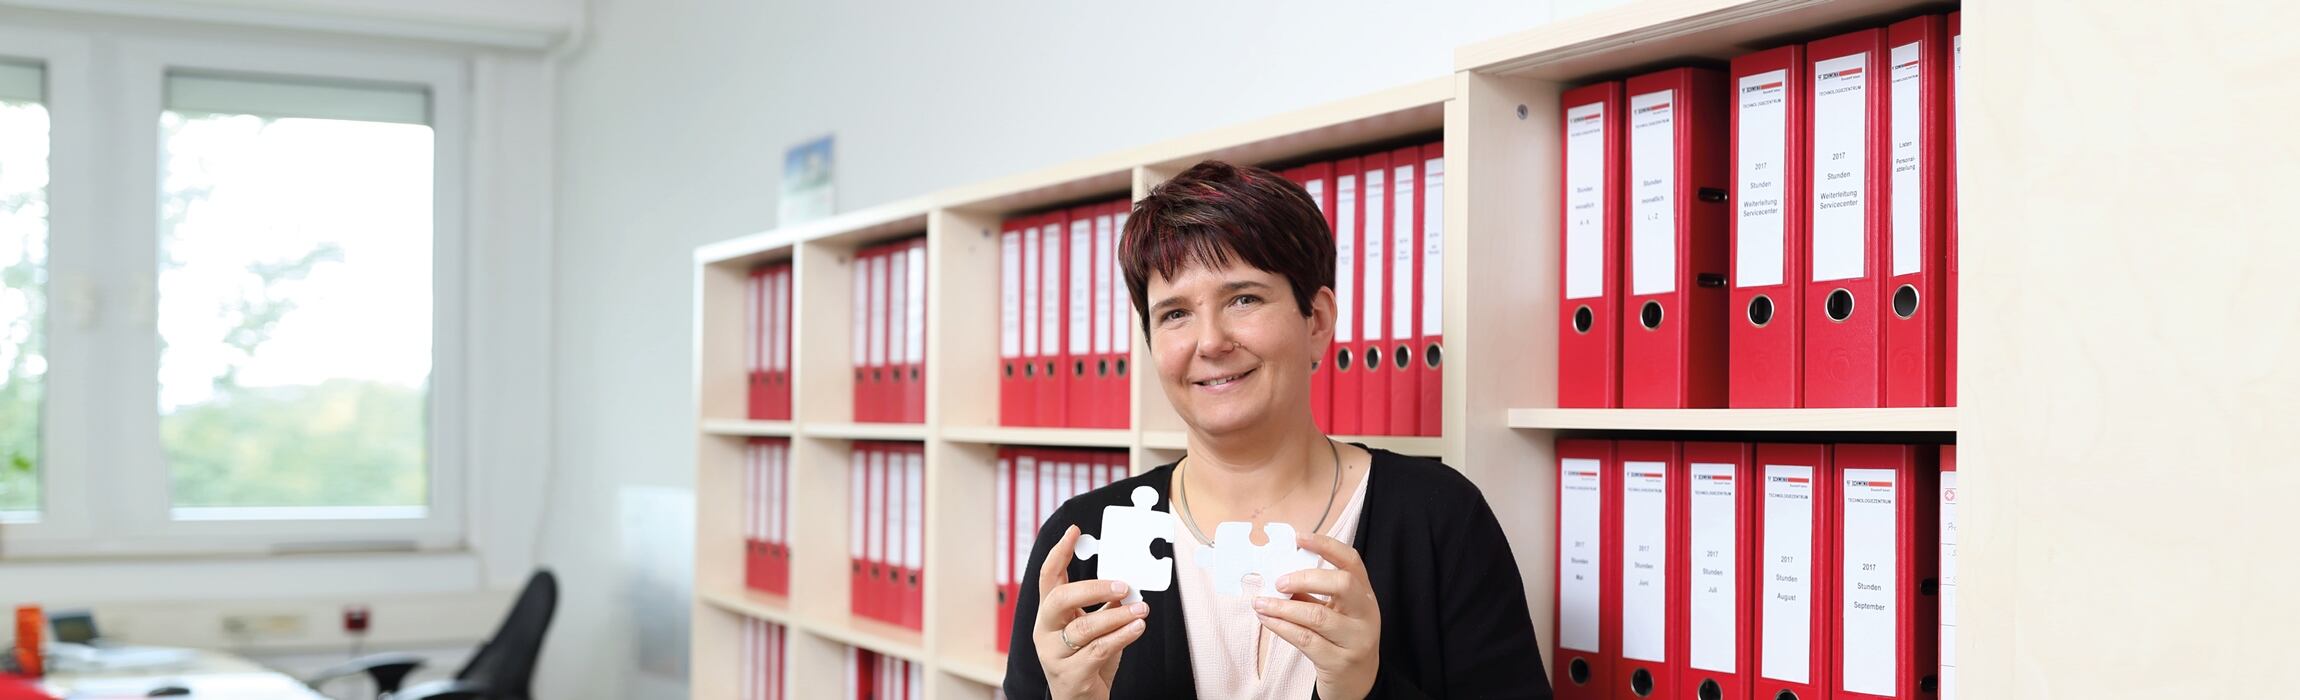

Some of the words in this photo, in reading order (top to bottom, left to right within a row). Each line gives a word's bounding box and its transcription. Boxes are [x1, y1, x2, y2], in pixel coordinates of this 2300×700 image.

[1832, 152, 1846, 161] 2017
[1755, 162, 1767, 171] 2017
[1827, 171, 1851, 181] Stunden
[1750, 181, 1772, 190] Stunden
[1820, 190, 1858, 200] Weiterleitung
[1744, 198, 1778, 207] Weiterleitung
[1820, 199, 1858, 210] Servicecenter
[1743, 207, 1778, 217] Servicecenter
[1707, 550, 1719, 558] 2017
[1781, 555, 1794, 563] 2017
[1862, 563, 1876, 571] 2017
[1702, 568, 1723, 576] Stunden
[1776, 573, 1798, 583] Stunden
[1857, 582, 1882, 591] Stunden
[1777, 592, 1796, 602] August
[1854, 601, 1886, 611] September
